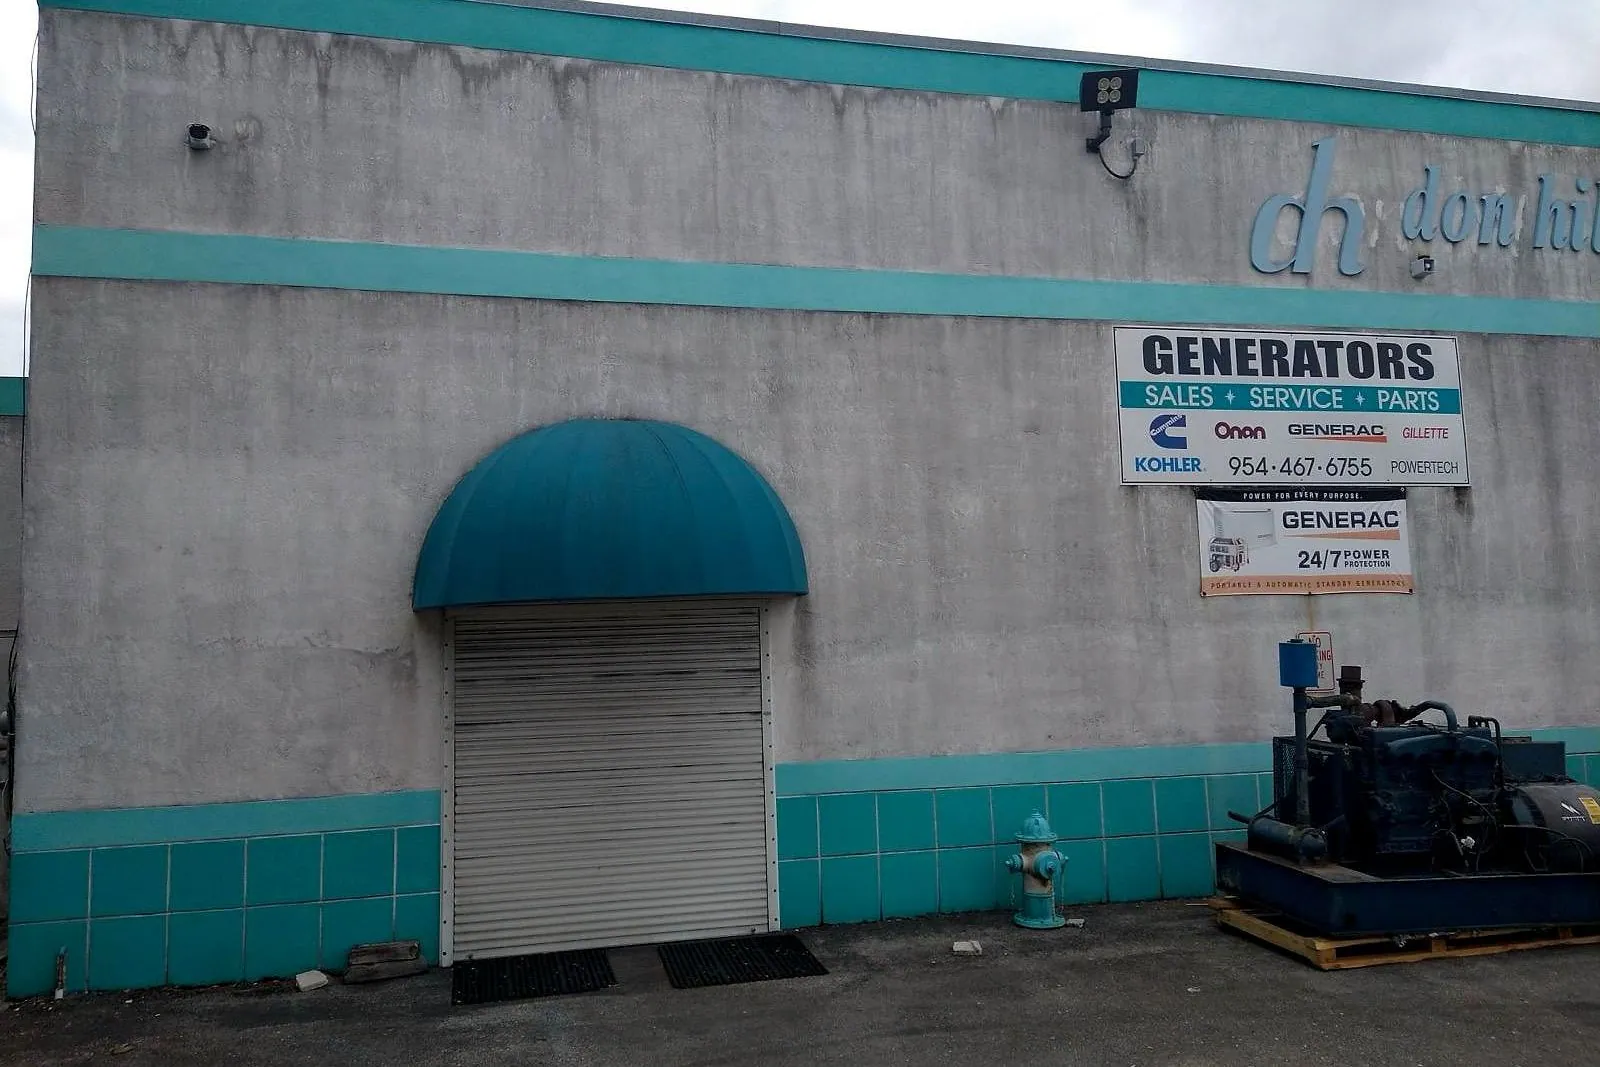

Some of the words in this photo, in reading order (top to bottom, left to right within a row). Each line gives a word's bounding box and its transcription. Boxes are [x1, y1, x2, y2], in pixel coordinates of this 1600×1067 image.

[1402, 164, 1517, 248] don
[1142, 335, 1435, 381] GENERATORS
[1145, 385, 1214, 407] SALES
[1250, 387, 1343, 409] SERVICE
[1378, 390, 1440, 411] PARTS
[1215, 421, 1266, 439] Onan
[1288, 424, 1384, 436] GENERAC
[1403, 427, 1449, 439] GILLETTE
[1135, 457, 1201, 472] KOHLER
[1391, 460, 1459, 474] POWERTECH
[1294, 491, 1319, 499] EVERY
[1282, 510, 1399, 529] GENERAC
[1298, 549, 1342, 570] 24/7
[1344, 549, 1390, 559] POWER
[1344, 560, 1391, 568] PROTECTION
[1265, 580, 1312, 589] AUTOMATIC
[1316, 580, 1351, 588] STANDBY
